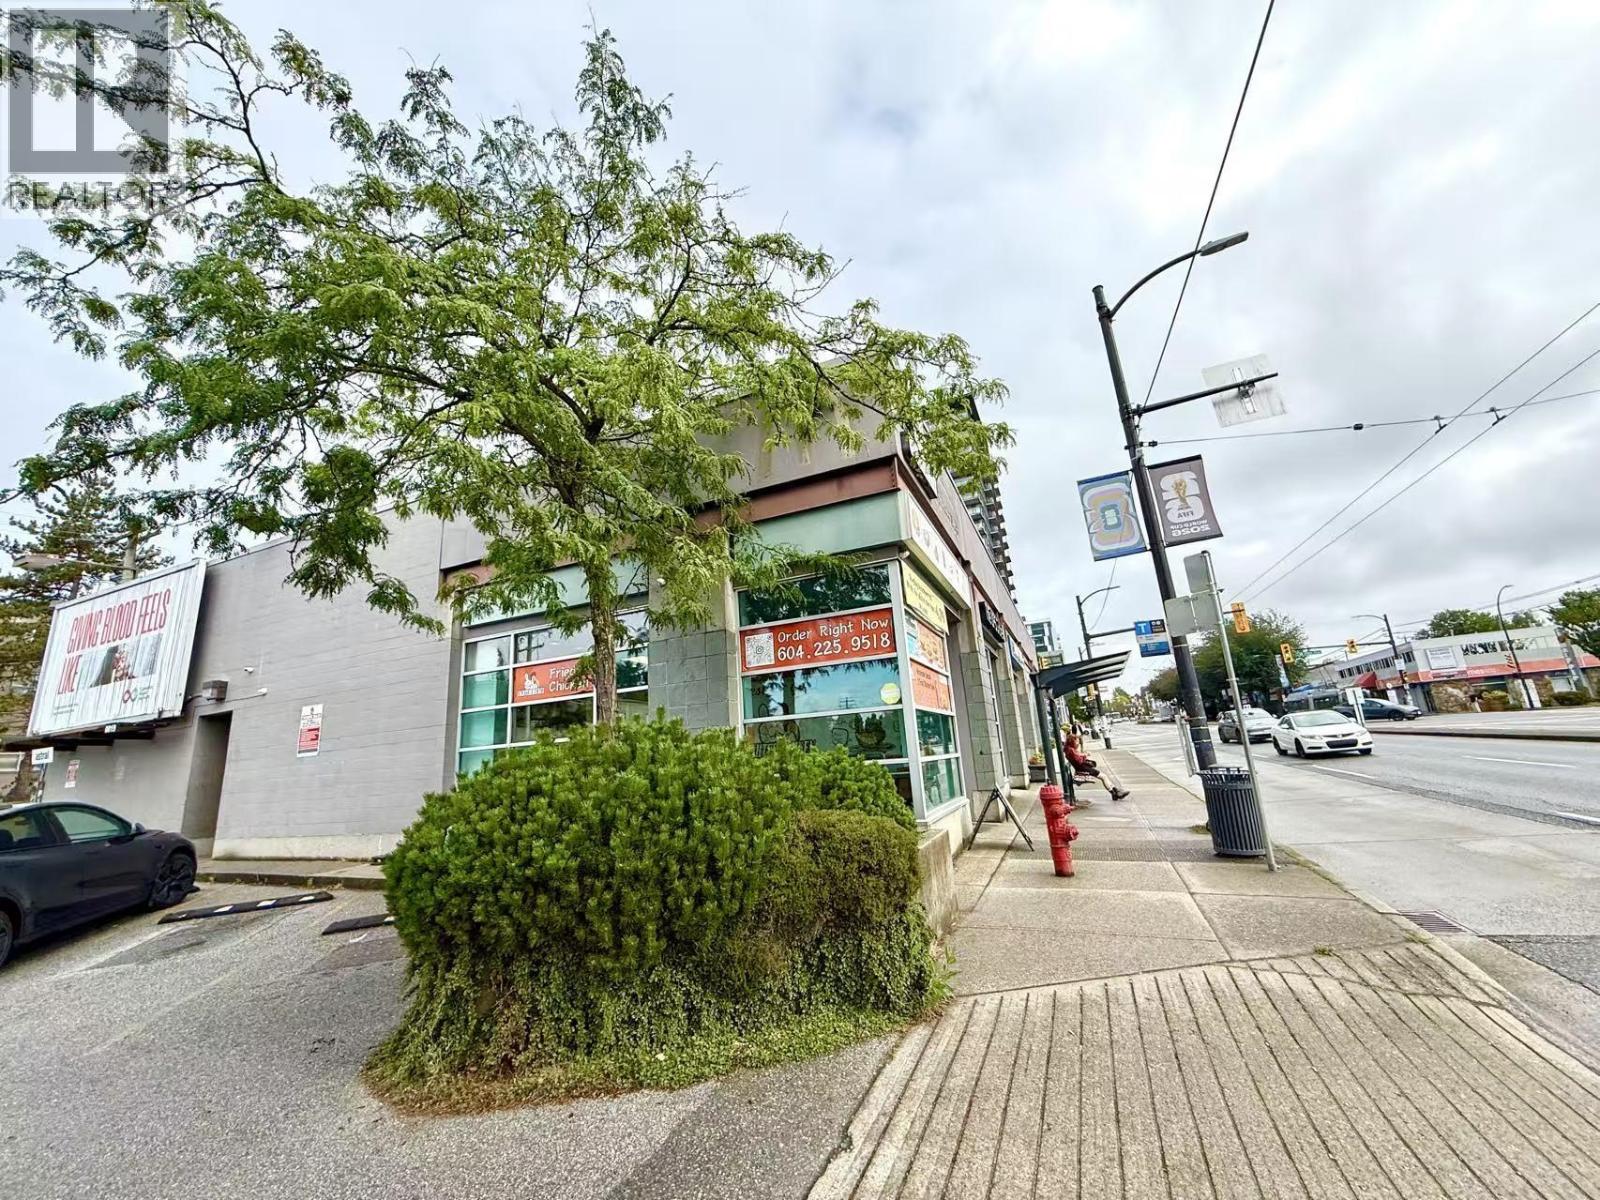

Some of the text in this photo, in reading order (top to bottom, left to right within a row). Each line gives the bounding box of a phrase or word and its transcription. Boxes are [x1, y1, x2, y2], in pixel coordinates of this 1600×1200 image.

[66, 588, 171, 655] GIVING BLOOD FEELS
[777, 618, 889, 643] Order Right Now
[777, 632, 891, 661] 604.225.9518
[57, 654, 82, 695] LIKE
[549, 665, 576, 680] Fried
